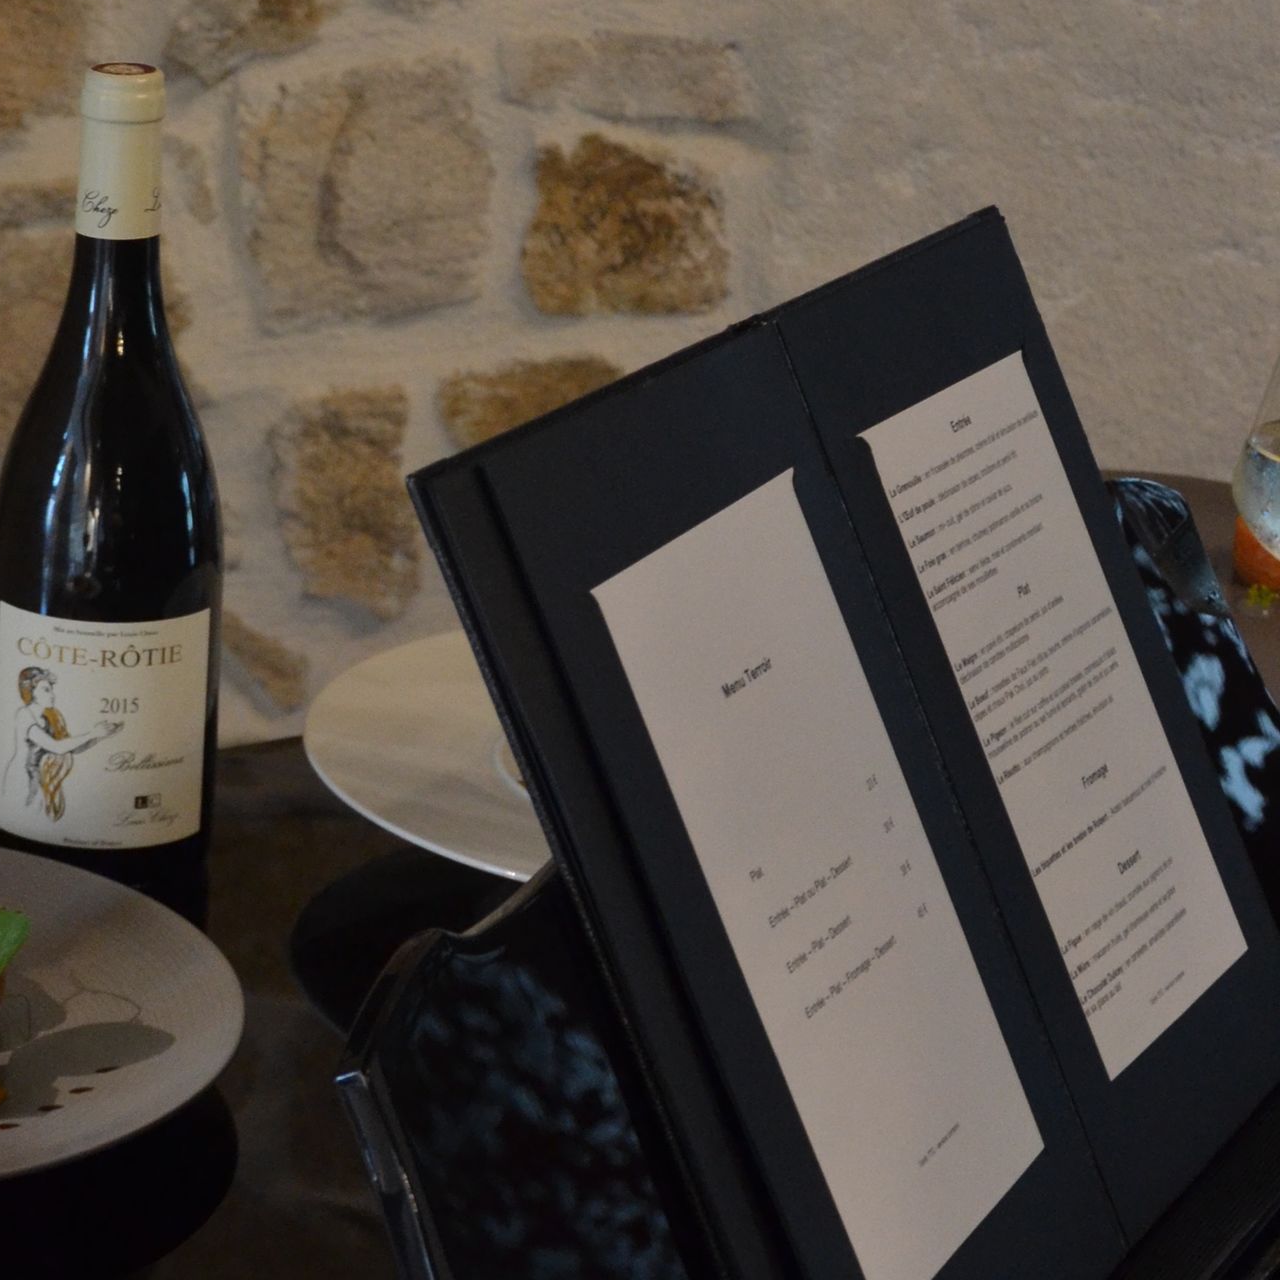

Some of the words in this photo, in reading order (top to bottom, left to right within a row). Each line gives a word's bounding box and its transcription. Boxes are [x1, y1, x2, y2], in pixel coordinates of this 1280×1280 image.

[17, 635, 183, 668] CÔTE-RÔTIE
[721, 678, 746, 697] Menu
[743, 658, 771, 681] Terroir
[99, 697, 140, 715] 2015
[1081, 763, 1108, 787] Fromage
[1117, 849, 1140, 874] Dessert
